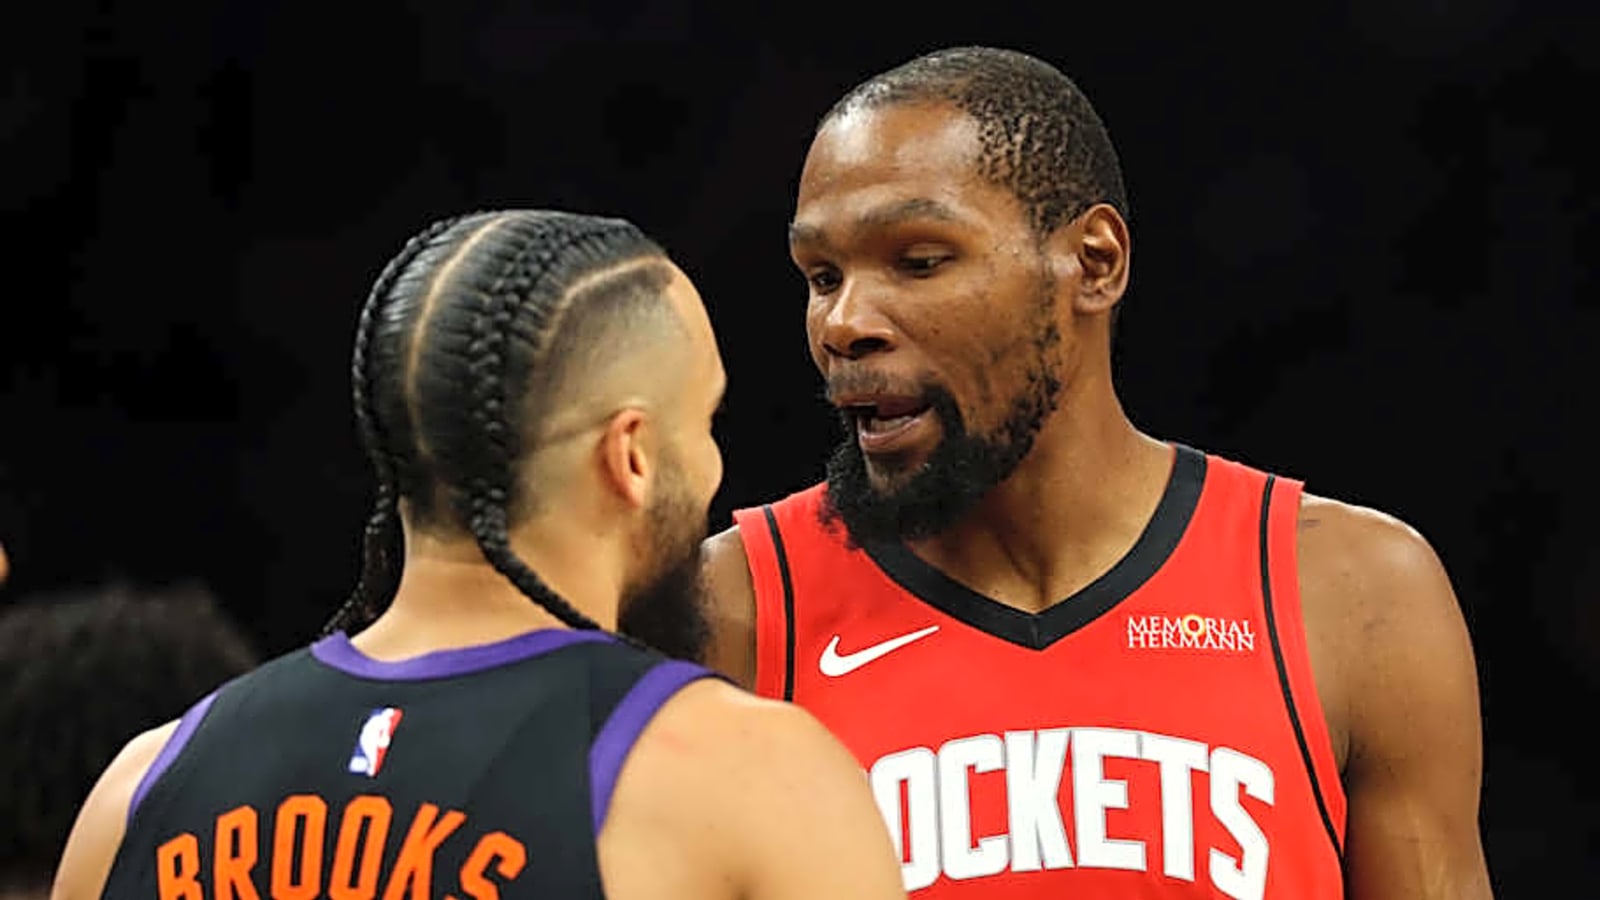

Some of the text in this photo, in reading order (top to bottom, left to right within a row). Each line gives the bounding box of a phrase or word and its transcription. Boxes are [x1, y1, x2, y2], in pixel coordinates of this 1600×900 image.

[1127, 614, 1254, 637] MEMORIAL
[1128, 631, 1255, 651] HERMANN
[863, 727, 1275, 900] OCKETS
[157, 795, 527, 900] BROOKS
